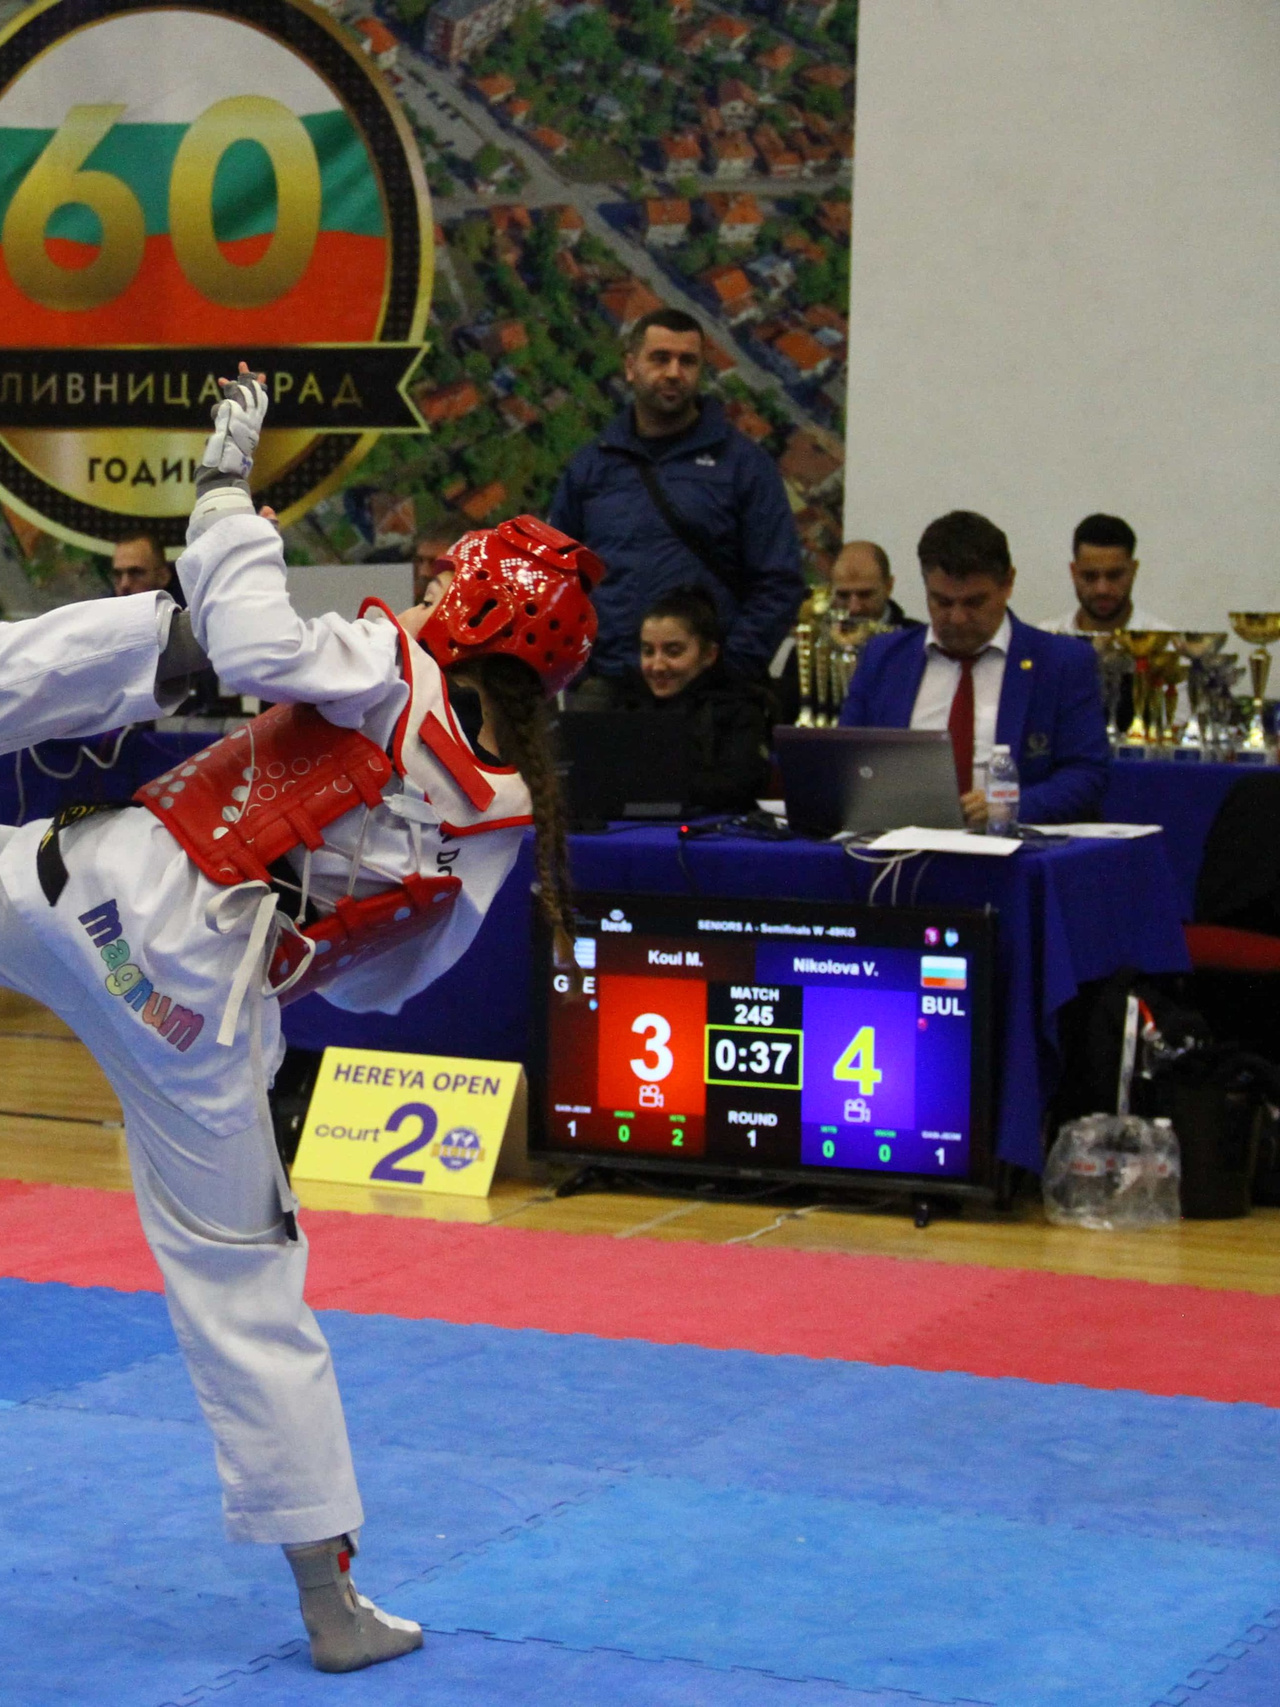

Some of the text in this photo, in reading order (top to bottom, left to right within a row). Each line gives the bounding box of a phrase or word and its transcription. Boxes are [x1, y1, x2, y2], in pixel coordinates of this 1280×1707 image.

[1, 94, 322, 312] 60
[272, 373, 363, 408] РАД
[685, 952, 704, 967] M.
[793, 957, 879, 977] Nikolova V.
[77, 898, 205, 1052] magnum
[553, 974, 596, 994] GE
[730, 986, 780, 1001] MATCH
[734, 1004, 774, 1026] 245
[921, 995, 966, 1016] BUL
[630, 1013, 674, 1082] 3
[715, 1039, 792, 1075] 0:37
[833, 1026, 882, 1096] 4
[333, 1063, 501, 1096] HEREYA OPEN
[567, 1120, 577, 1137] 1
[728, 1110, 778, 1127] ROUND
[315, 1124, 381, 1143] court
[370, 1102, 438, 1185] 2
[618, 1125, 630, 1142] 0
[672, 1129, 684, 1146] 2
[747, 1130, 757, 1147] 1
[822, 1140, 835, 1158] 0
[878, 1144, 891, 1162] 0
[935, 1147, 946, 1165] 1
